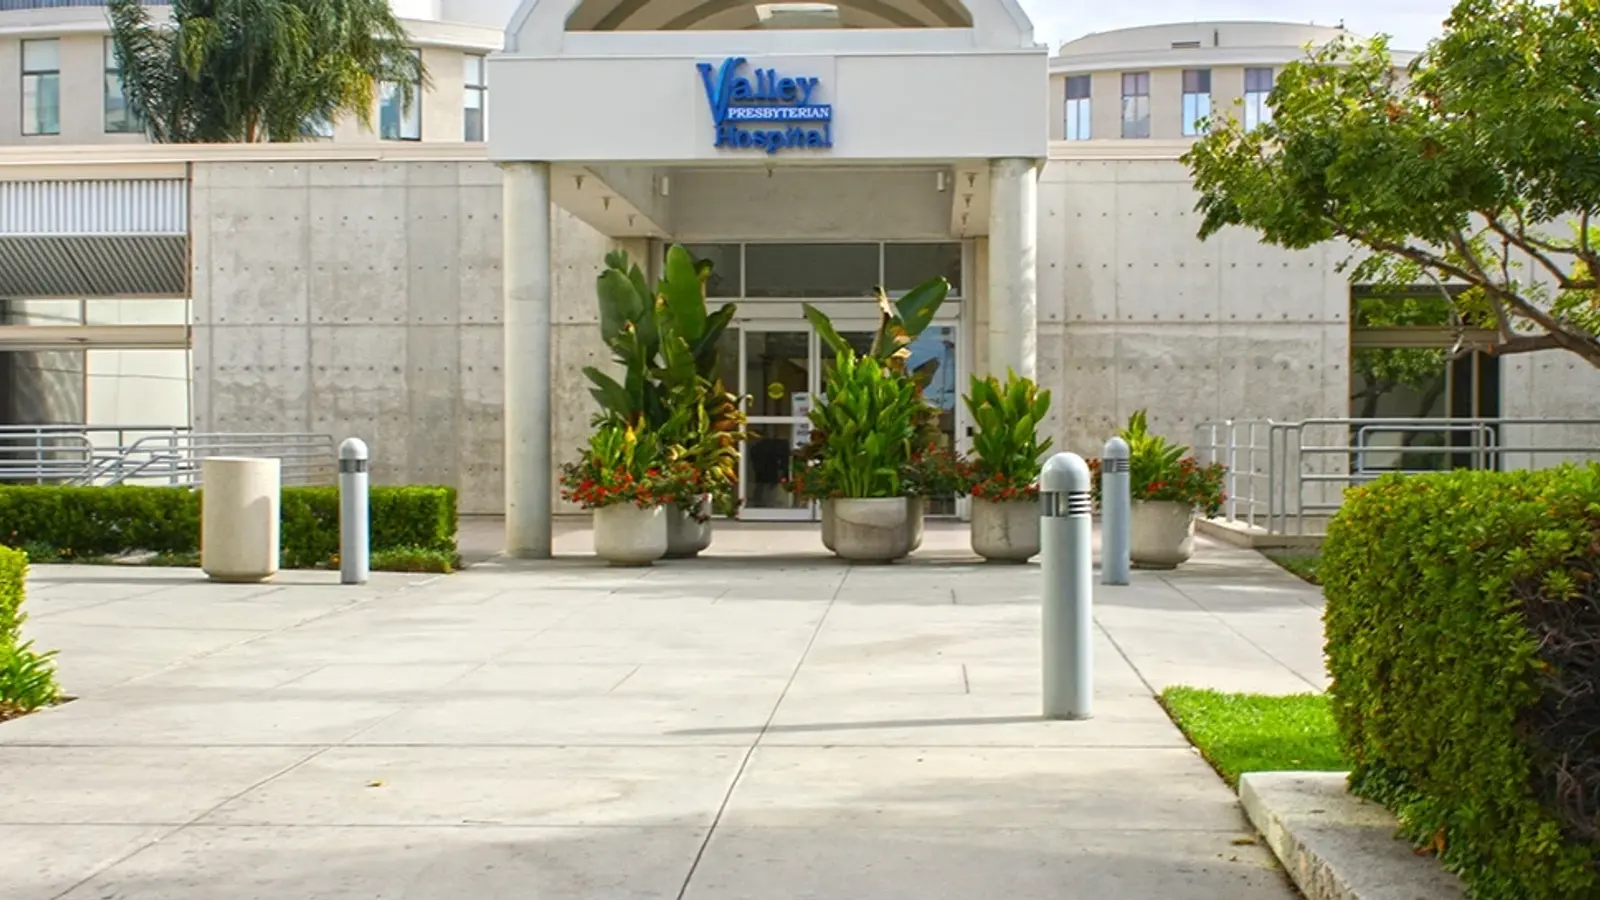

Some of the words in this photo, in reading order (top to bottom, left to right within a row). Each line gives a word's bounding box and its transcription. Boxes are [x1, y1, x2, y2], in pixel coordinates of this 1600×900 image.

[696, 57, 819, 125] Valley
[728, 106, 829, 119] PRESBYTERIAN
[713, 124, 832, 154] Hospital
